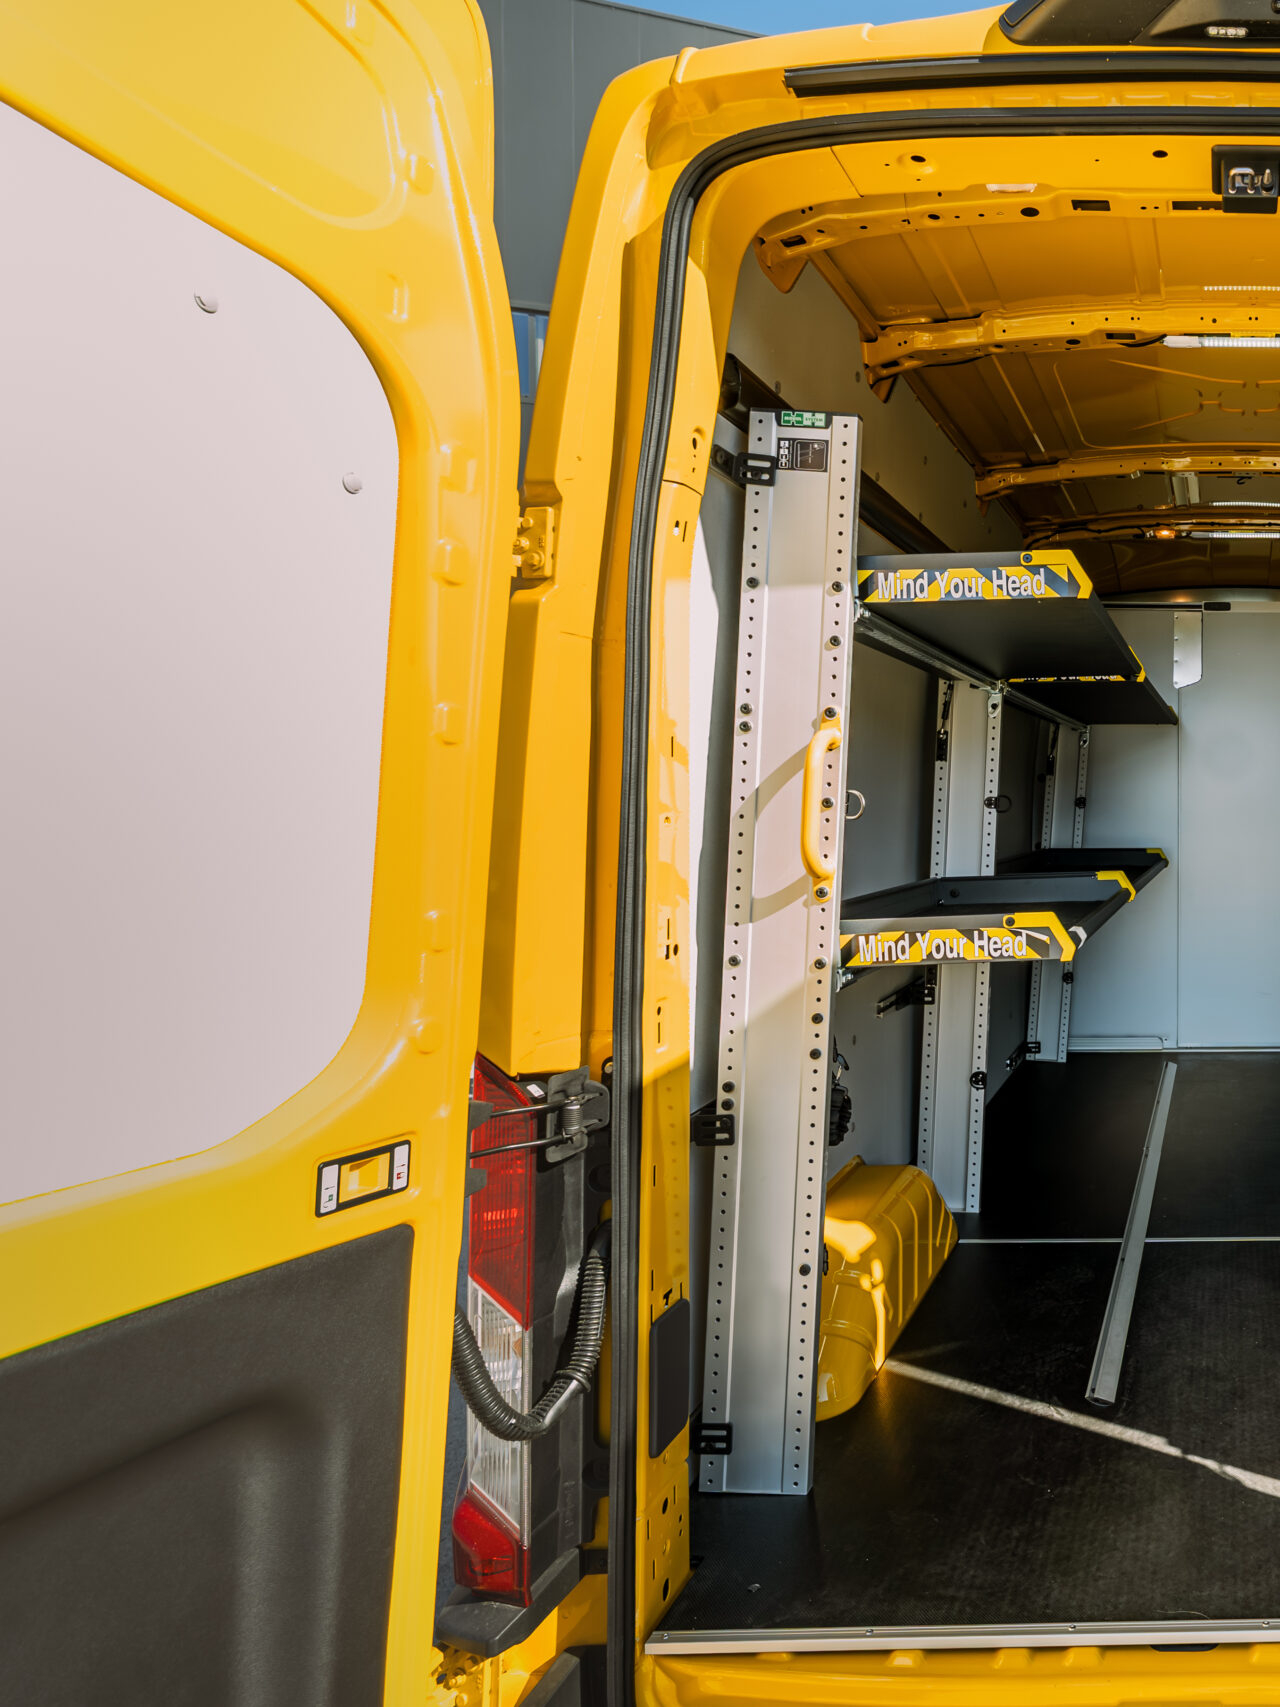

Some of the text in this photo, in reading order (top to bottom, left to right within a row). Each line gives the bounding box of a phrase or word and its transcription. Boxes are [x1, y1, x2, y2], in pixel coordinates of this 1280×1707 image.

[877, 567, 1046, 599] Mind Your Head
[858, 930, 1028, 963] Mind Your Head
